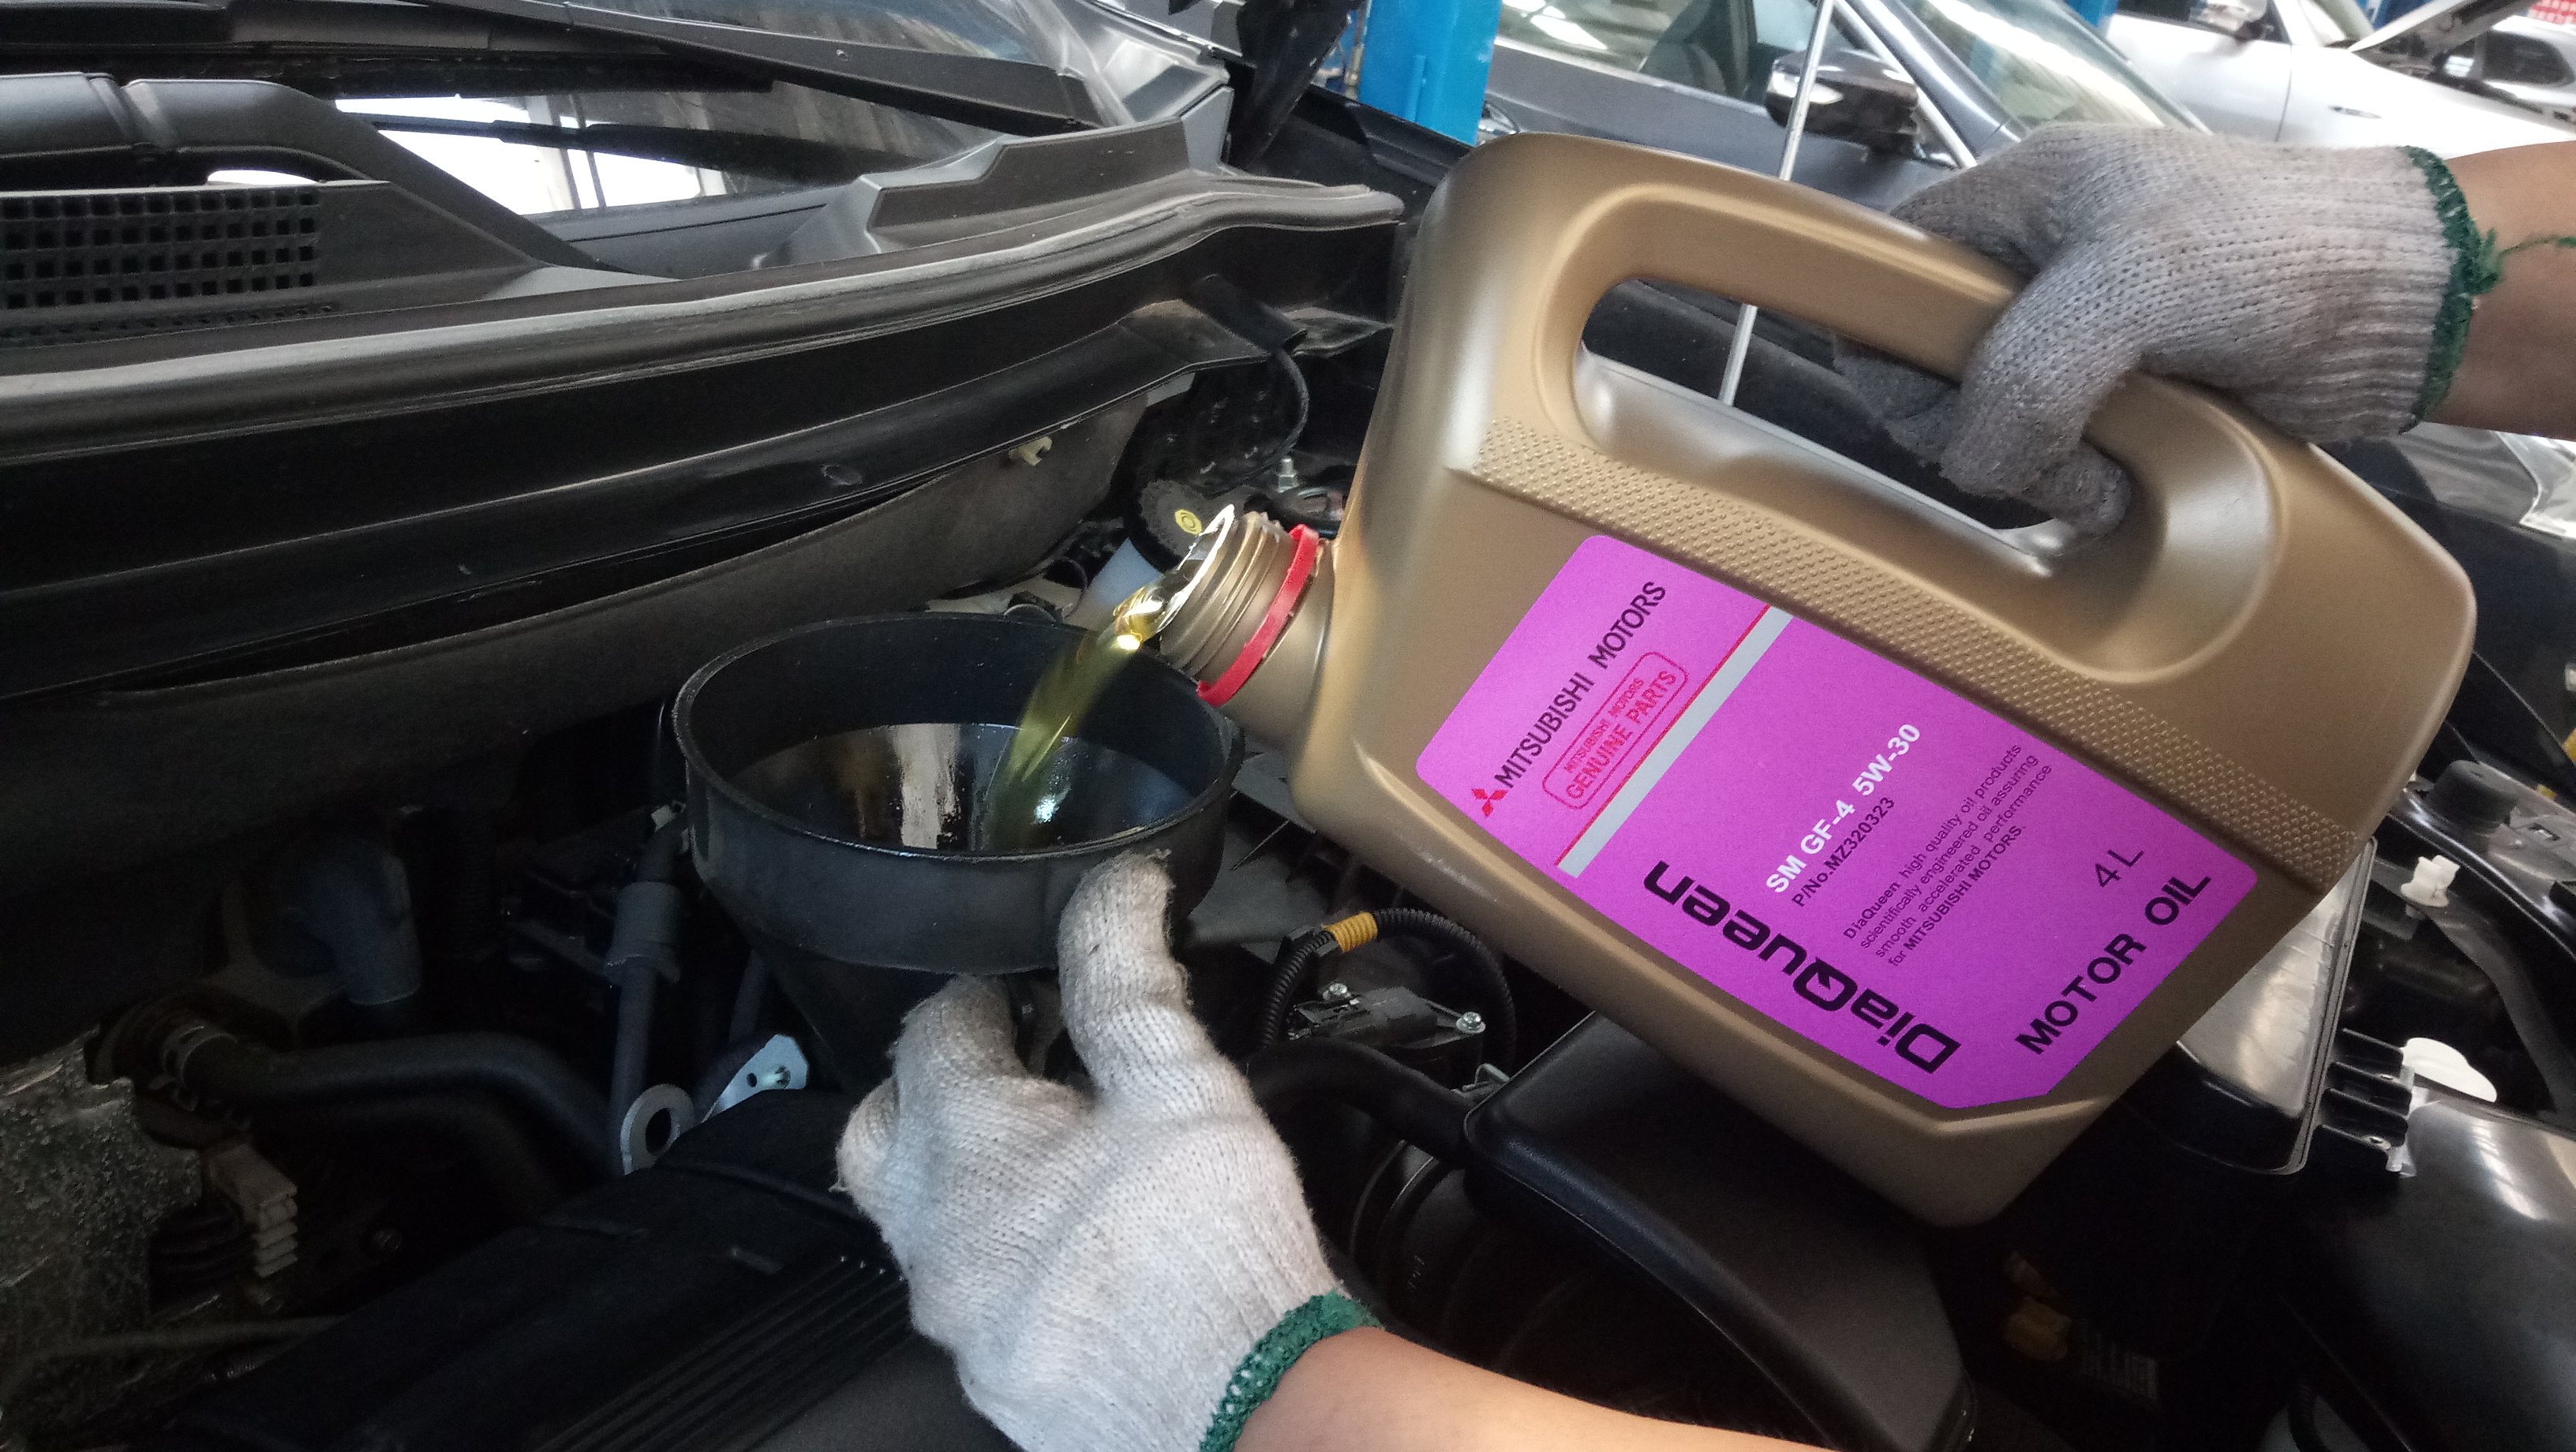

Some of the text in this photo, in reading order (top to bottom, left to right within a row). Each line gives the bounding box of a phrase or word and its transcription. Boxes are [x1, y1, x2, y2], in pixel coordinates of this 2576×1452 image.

[1494, 581, 1666, 789] MITSUBISHI MOTORS
[1563, 678, 1645, 773] MITSUBISHI MOTORS
[1566, 670, 1676, 799] GENUINE PARTS
[1765, 724, 1920, 893] SM GF-4 5W-30
[1792, 797, 1895, 908] P/No.MZ320323
[1843, 744, 2022, 939] DiaQueen high quality oil products
[1860, 754, 2039, 949] scientifically engineered oil assuring
[1875, 765, 2052, 958] smooth accelerated performance
[1643, 861, 1962, 1075] DiaQueen
[1888, 950, 1907, 967] for
[1903, 880, 1972, 951] MITSUBISHI
[2014, 876, 2212, 1055] MOTOR OIL
